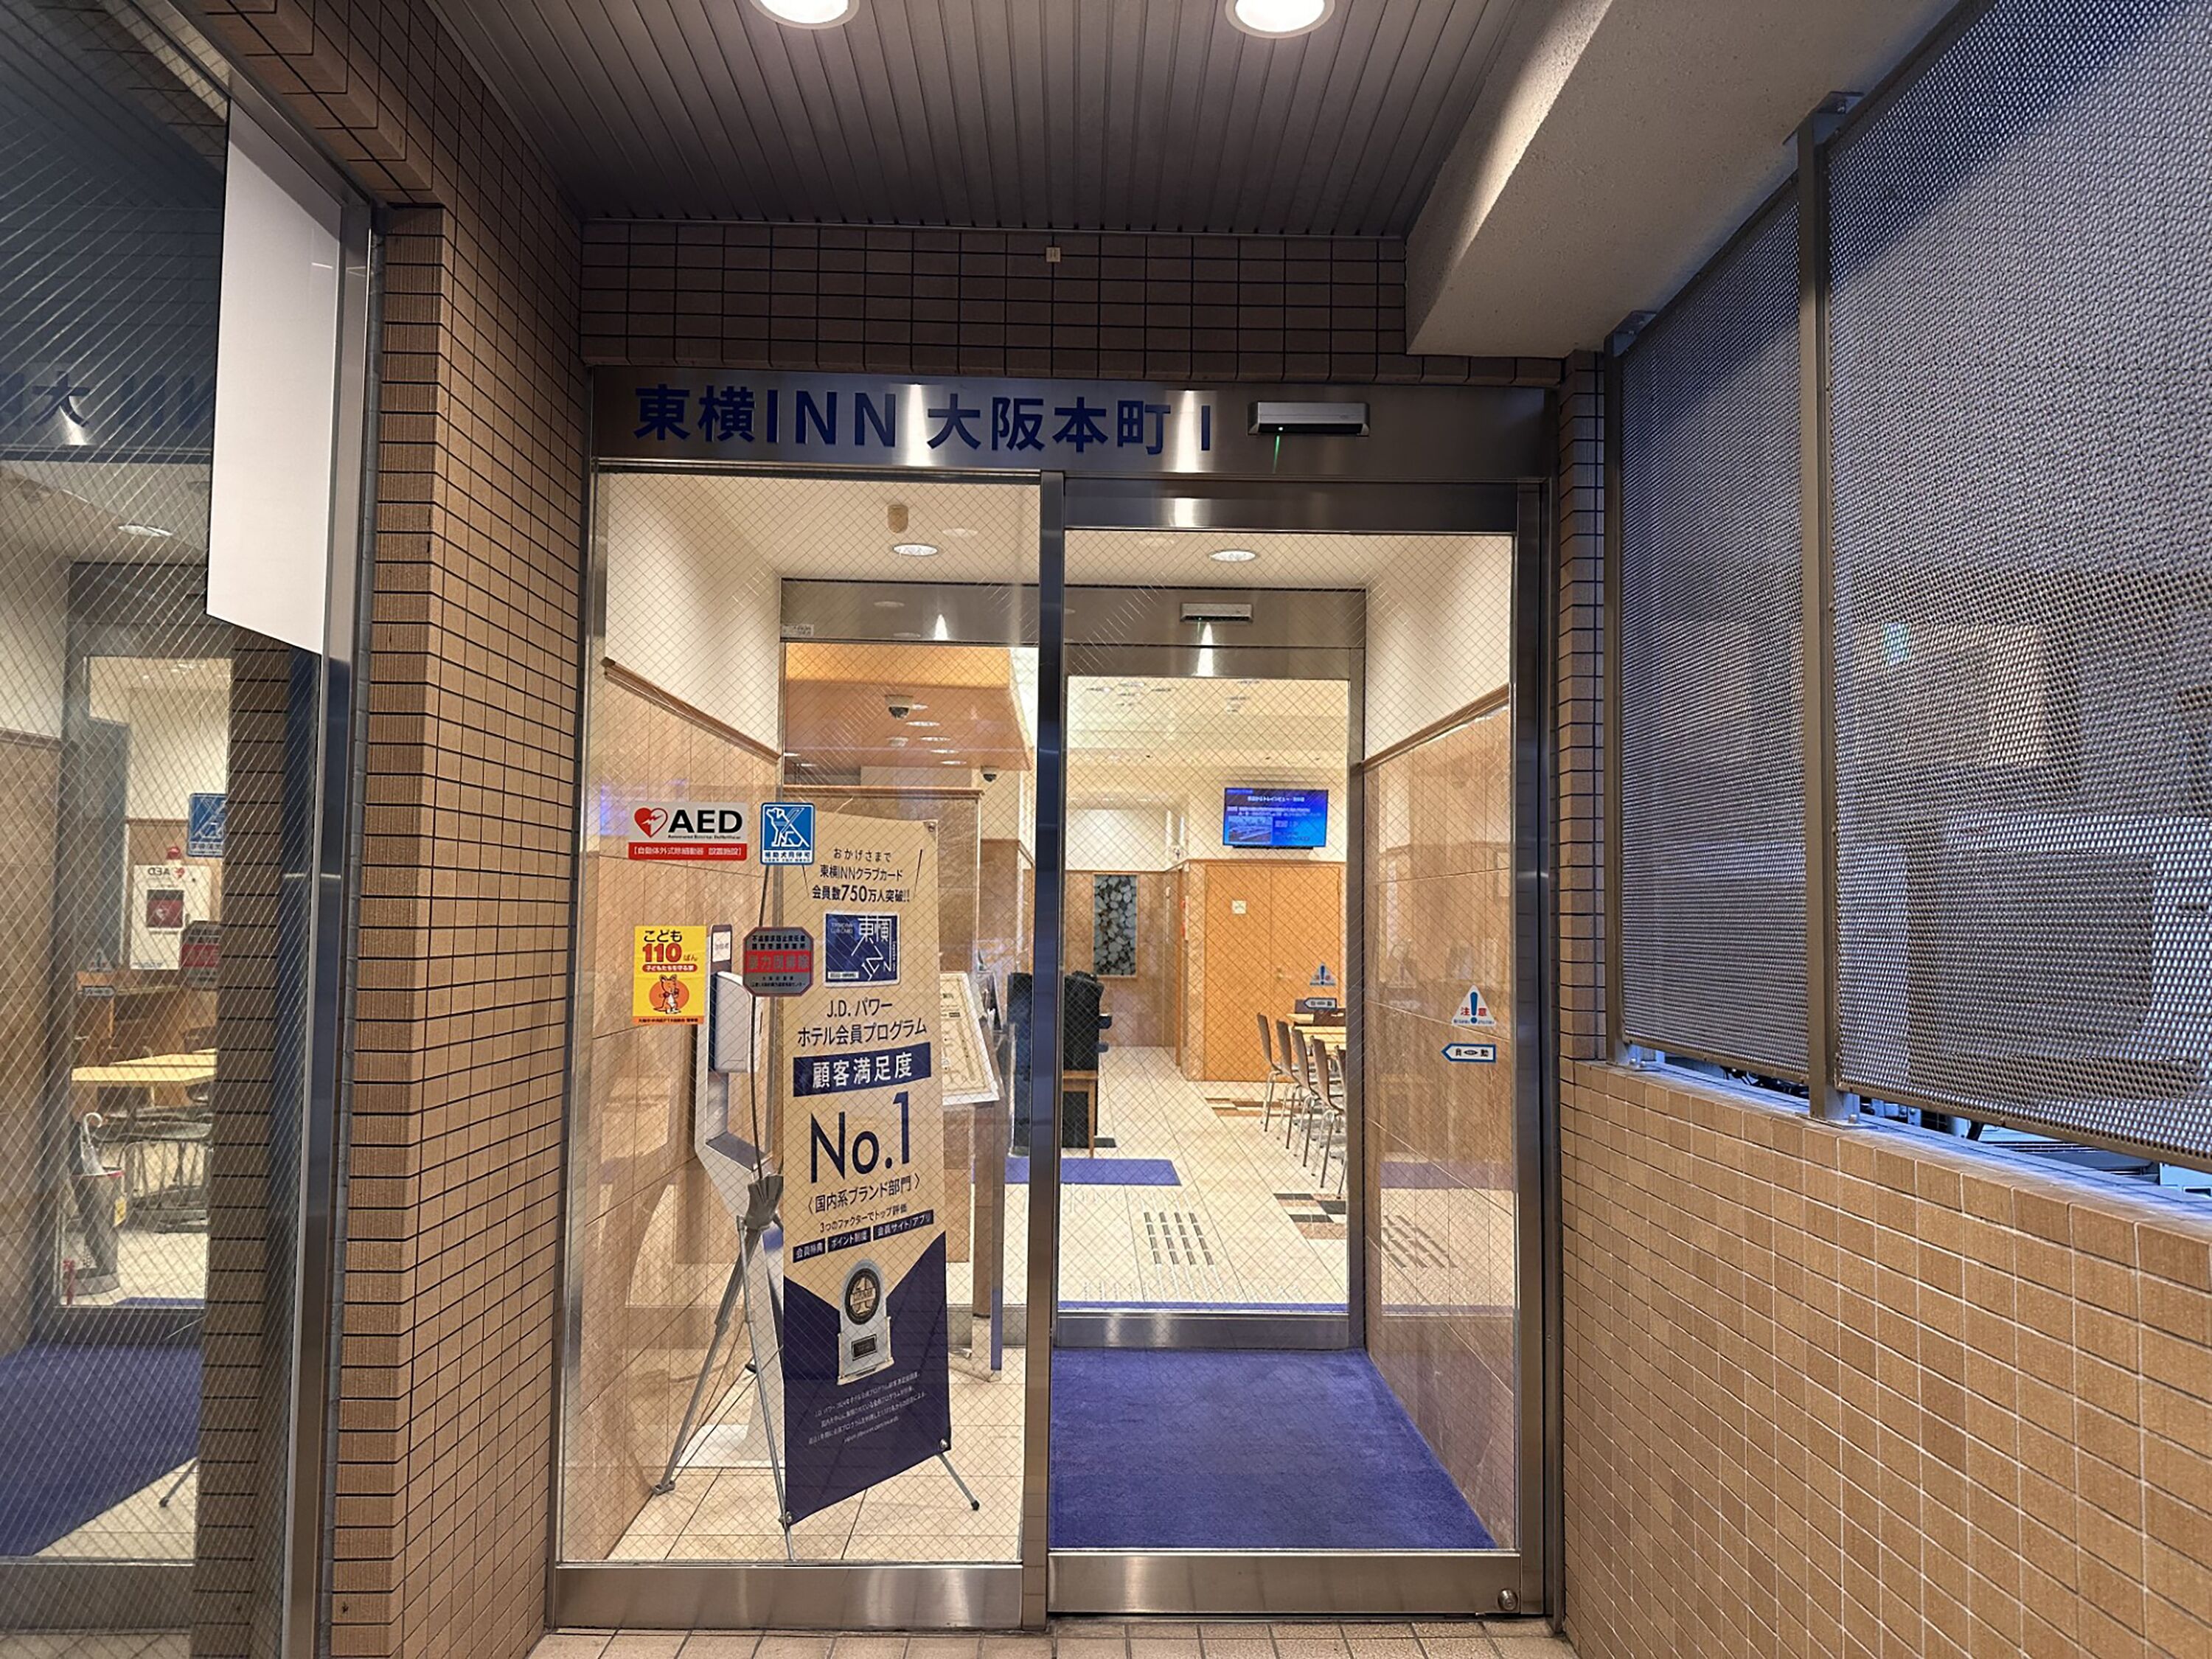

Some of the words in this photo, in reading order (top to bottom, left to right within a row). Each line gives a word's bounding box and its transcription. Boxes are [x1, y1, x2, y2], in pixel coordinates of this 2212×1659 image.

[633, 383, 896, 448] 東横INN
[927, 393, 1172, 455] 大阪本町
[668, 810, 742, 833] AED
[834, 849, 891, 863] おかげさまで
[820, 864, 902, 881] 東横INNクラブカード
[644, 930, 682, 942] こども
[855, 997, 893, 1016] パワー
[797, 1018, 927, 1047] ホテル会員プログラム
[813, 1051, 912, 1089] 顧客満足度
[811, 1091, 909, 1183] No.1
[819, 1203, 908, 1233] 3つのファクターでトップ評価
